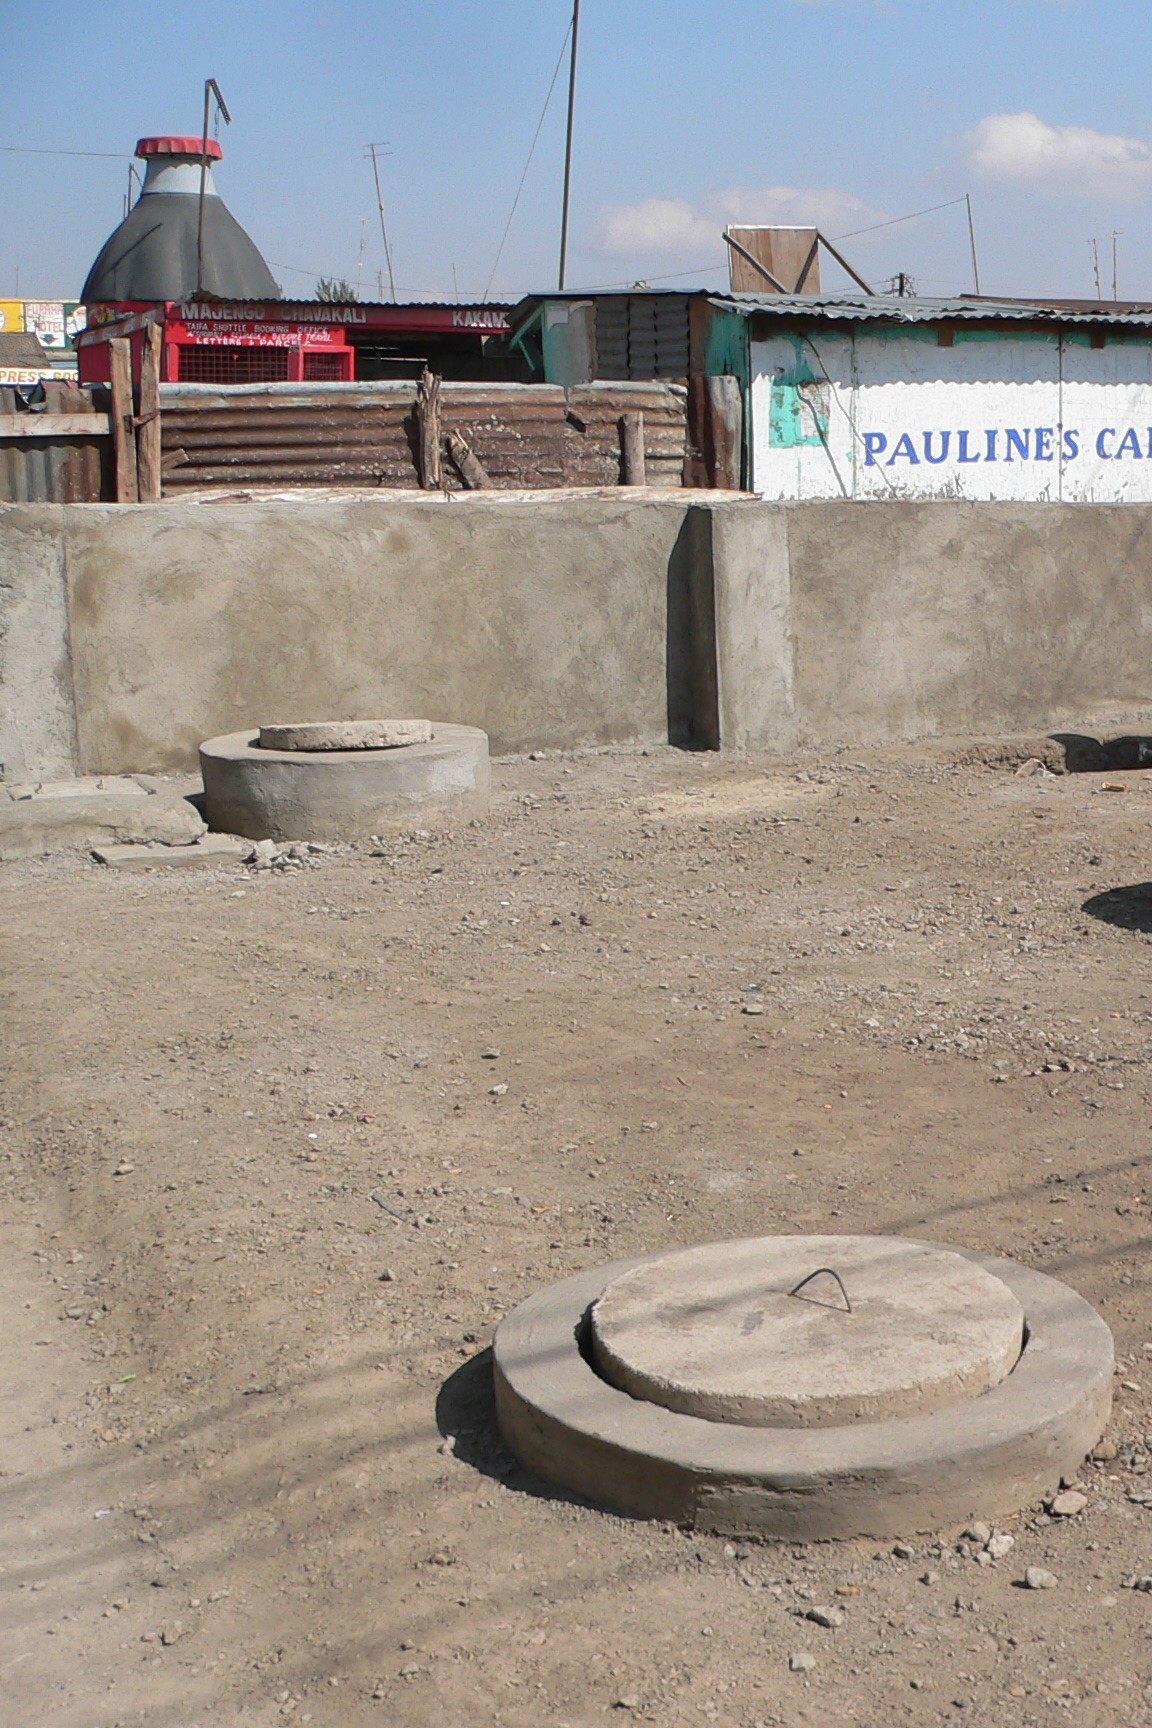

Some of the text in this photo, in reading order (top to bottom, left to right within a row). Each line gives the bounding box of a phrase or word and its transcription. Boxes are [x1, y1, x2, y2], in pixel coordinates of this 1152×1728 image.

[182, 303, 264, 321] MAJENGO
[281, 306, 368, 324] CHAVAKALI
[37, 321, 65, 333] HOTEL
[212, 323, 247, 333] SHUTTLE
[254, 324, 289, 334] BOOKING
[297, 326, 328, 335] OFFICE
[196, 337, 242, 346] LETTERS
[0, 370, 46, 383] PRESS
[861, 427, 1081, 466] PAULINES
